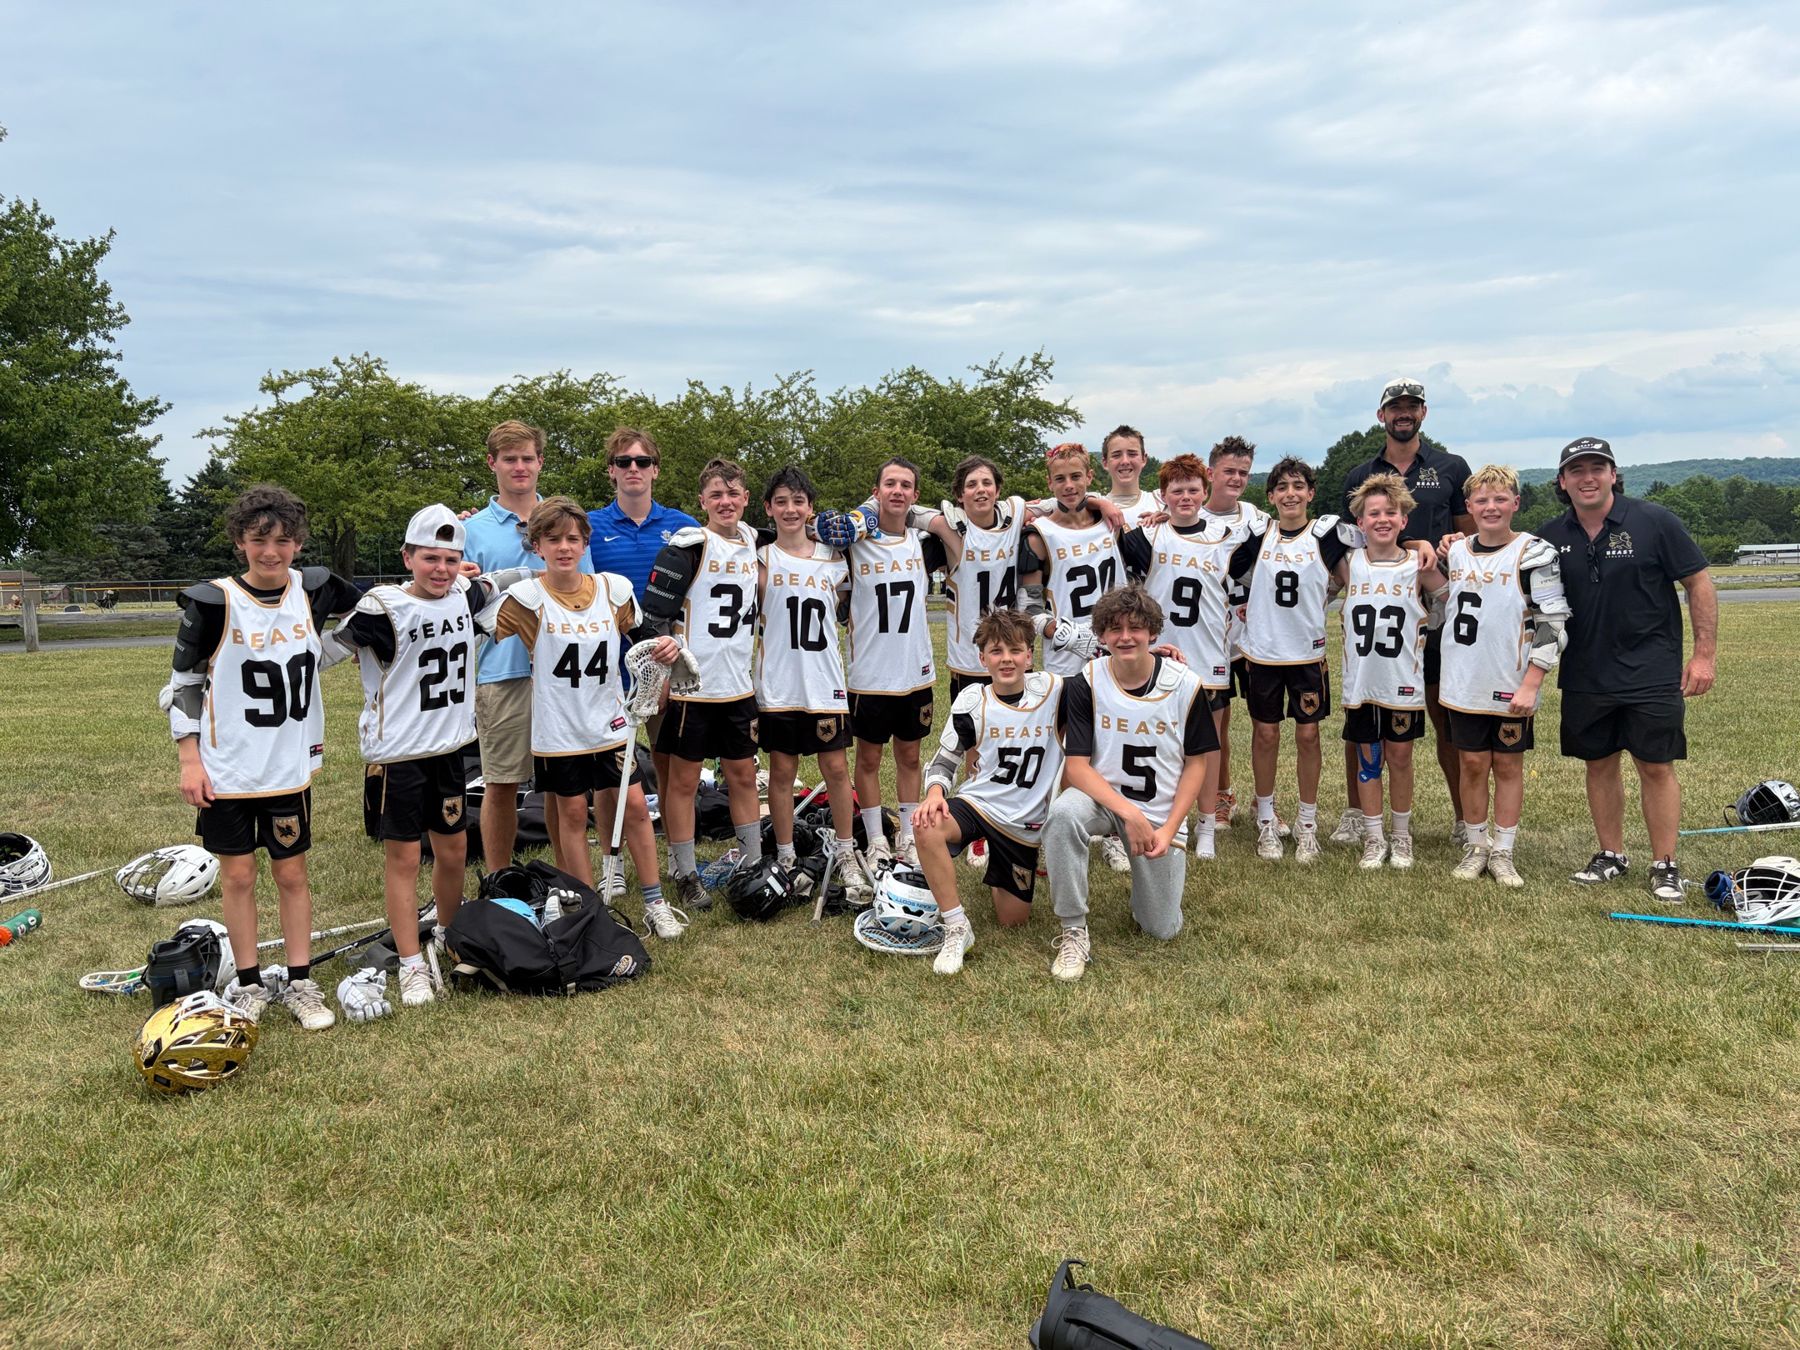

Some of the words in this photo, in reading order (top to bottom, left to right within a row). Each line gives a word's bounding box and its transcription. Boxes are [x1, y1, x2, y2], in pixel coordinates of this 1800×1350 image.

[860, 559, 922, 576] BEAST
[966, 545, 1014, 561] BEAS
[1056, 537, 1116, 560] BEAS
[1262, 550, 1315, 563] BEAST
[977, 565, 1016, 616] 14
[1066, 556, 1116, 618] 20
[1275, 570, 1299, 608] 8
[1350, 583, 1413, 598] BEAST
[1450, 569, 1512, 585] BEAST
[708, 584, 757, 638] 34
[786, 596, 828, 651] 10
[875, 580, 915, 633] 17
[1170, 576, 1202, 627] 9
[1454, 591, 1482, 646] 6
[547, 620, 610, 634] BEAST
[1352, 604, 1406, 658] 93
[241, 649, 315, 727] 90
[419, 641, 468, 712] 23
[552, 640, 608, 688] 44
[990, 726, 1053, 738] BEAST
[1101, 715, 1178, 735] BEAST
[990, 746, 1045, 789] 50
[1121, 744, 1157, 802] 5
